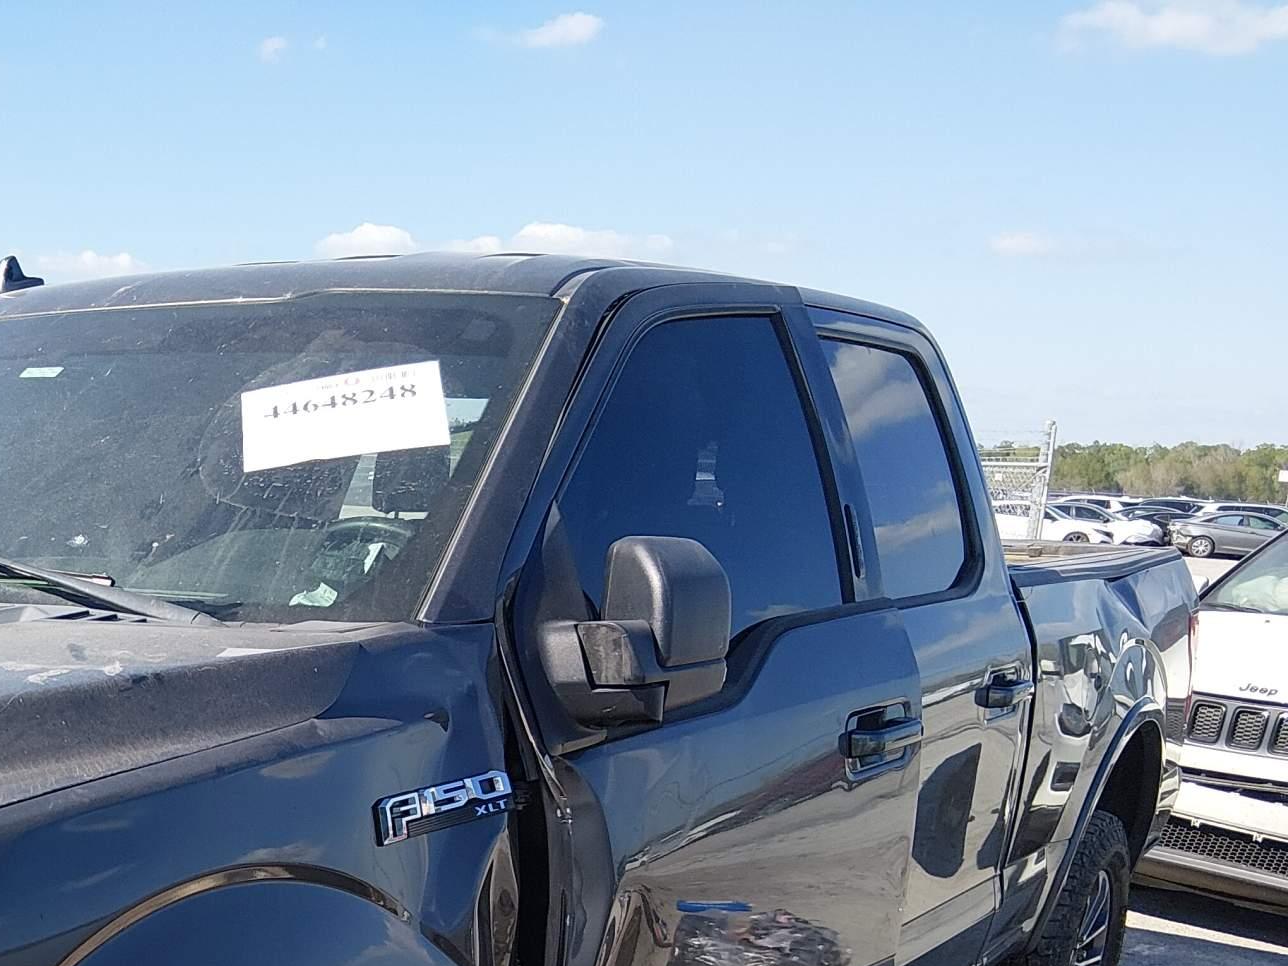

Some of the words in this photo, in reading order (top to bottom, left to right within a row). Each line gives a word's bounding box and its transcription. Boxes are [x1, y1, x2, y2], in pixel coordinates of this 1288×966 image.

[264, 383, 417, 418] 44648248
[1238, 682, 1279, 697] Jeep
[474, 798, 508, 817] XLT
